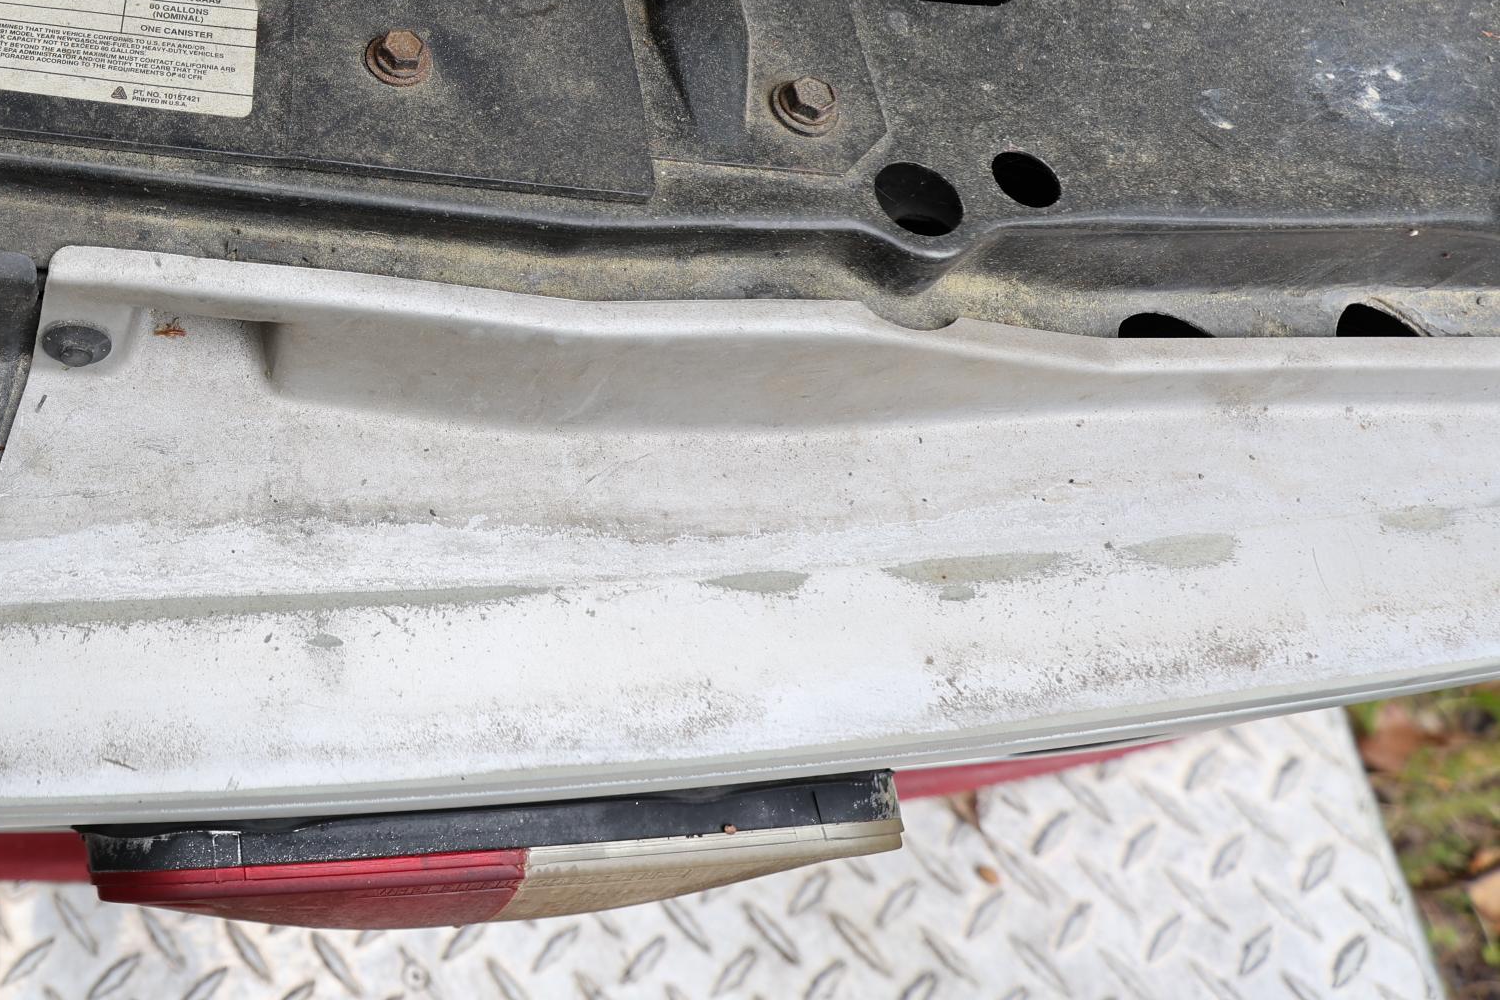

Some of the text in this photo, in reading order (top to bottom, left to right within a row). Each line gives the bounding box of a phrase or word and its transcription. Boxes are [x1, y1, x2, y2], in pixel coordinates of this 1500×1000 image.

[148, 2, 209, 16] 80 GALLONS
[152, 10, 204, 23] (NOMINAL)
[24, 25, 43, 33] THAT
[44, 27, 60, 35] THIS
[61, 29, 92, 38] VEHICLE
[92, 33, 134, 43] CONFORMS
[146, 38, 160, 46] U.S.
[161, 40, 176, 48] EPA
[176, 42, 205, 51] AND/OR
[139, 24, 213, 39] ONE CANISTER
[6, 34, 41, 43] CAPACITY
[42, 38, 60, 46] NOT
[70, 41, 99, 50] EXCEED
[8, 28, 34, 37] MODEL
[188, 49, 224, 58] VEHICLES
[9, 41, 39, 50] BEYOND
[56, 46, 81, 55] ABOVE
[82, 49, 117, 59] MAXIMUM
[118, 53, 138, 62] MUST
[139, 56, 174, 66] CONTACT
[175, 60, 218, 71] CALIFORNIA
[220, 65, 235, 73] ARB
[18, 47, 77, 60] ADMINISTRATOR
[77, 54, 106, 63] AND/OR
[107, 58, 132, 67] NOTIFY
[150, 63, 171, 71] CARB
[172, 65, 191, 73] THAT
[36, 55, 79, 66] ACCORDING
[107, 64, 164, 76] REQUIREMENTS
[165, 70, 176, 78] OF
[186, 73, 203, 81] CFR
[131, 95, 159, 104] PRINTED
[163, 92, 200, 103] 10157421
